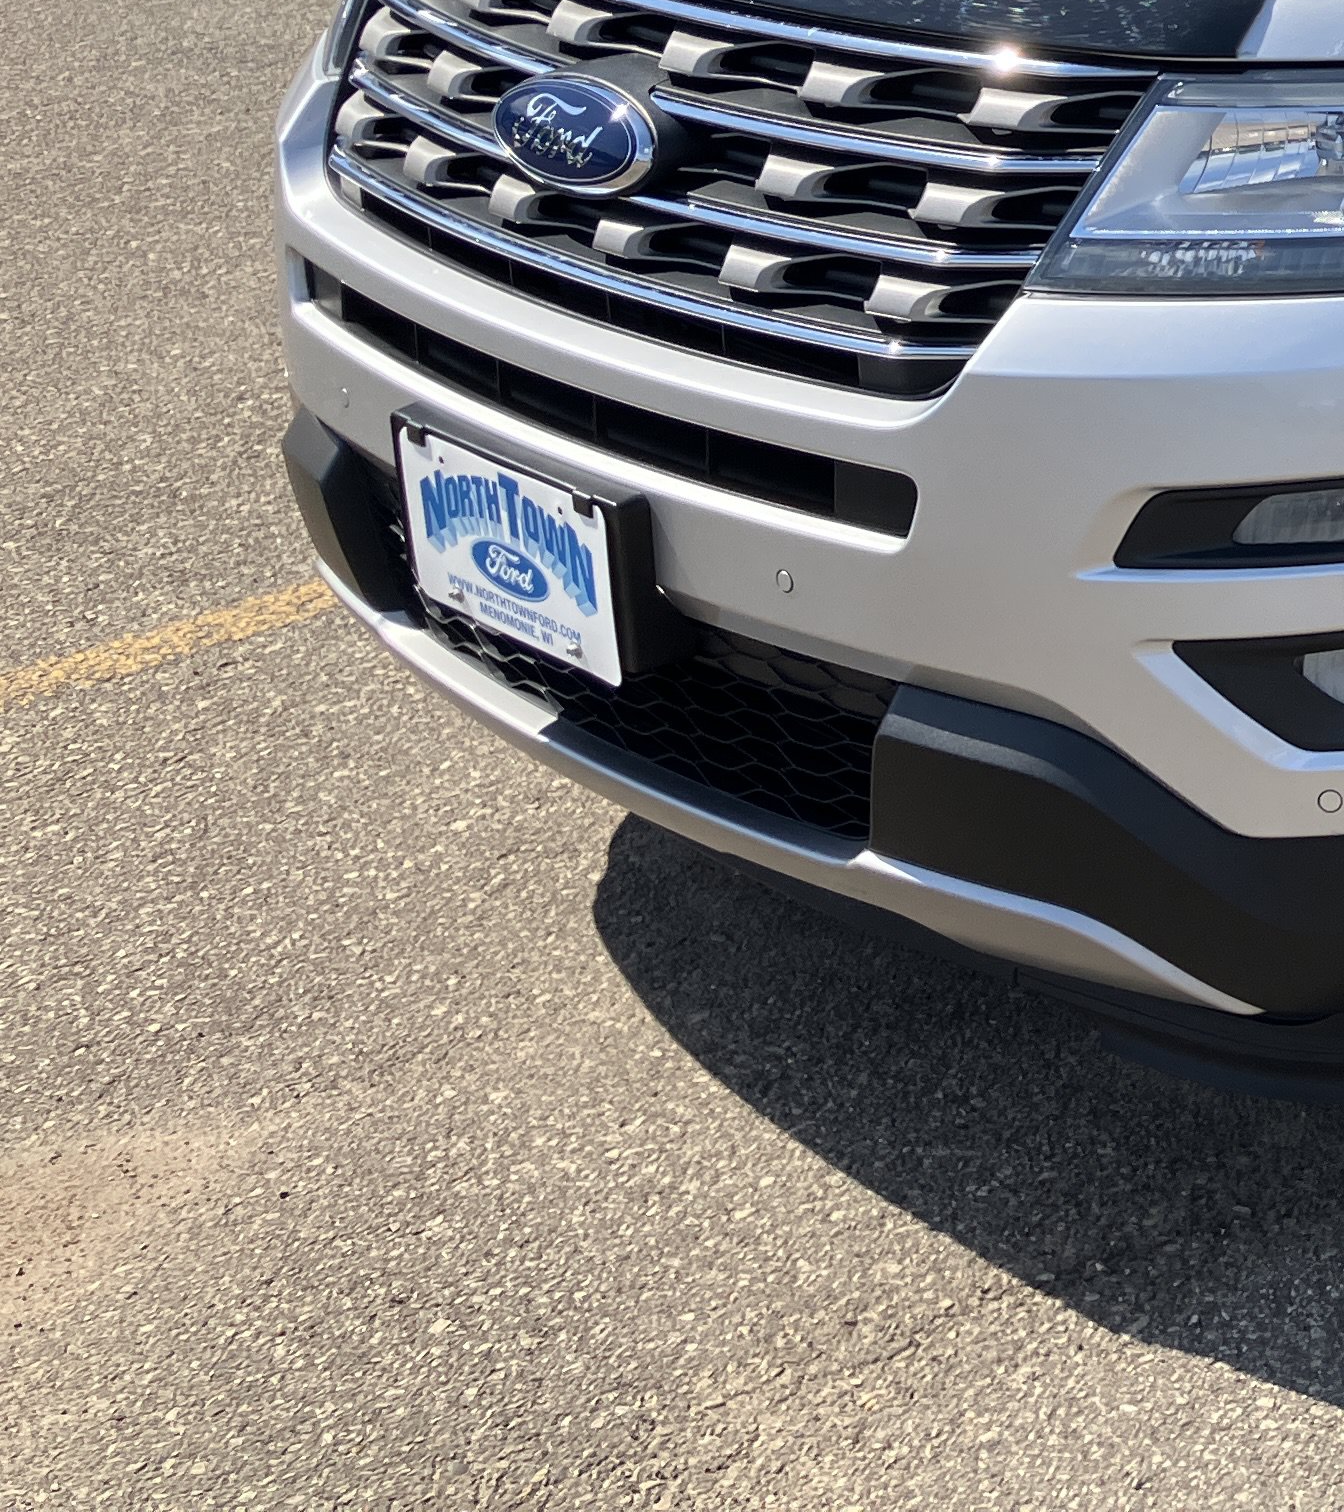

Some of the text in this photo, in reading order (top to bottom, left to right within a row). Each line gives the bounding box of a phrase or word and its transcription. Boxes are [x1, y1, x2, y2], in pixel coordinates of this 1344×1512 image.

[512, 92, 603, 169] Ford
[485, 543, 536, 595] Ford
[447, 572, 582, 642] WWW.NORTHTOWNFORD.COM
[479, 602, 554, 646] MENOMONIE, WI
